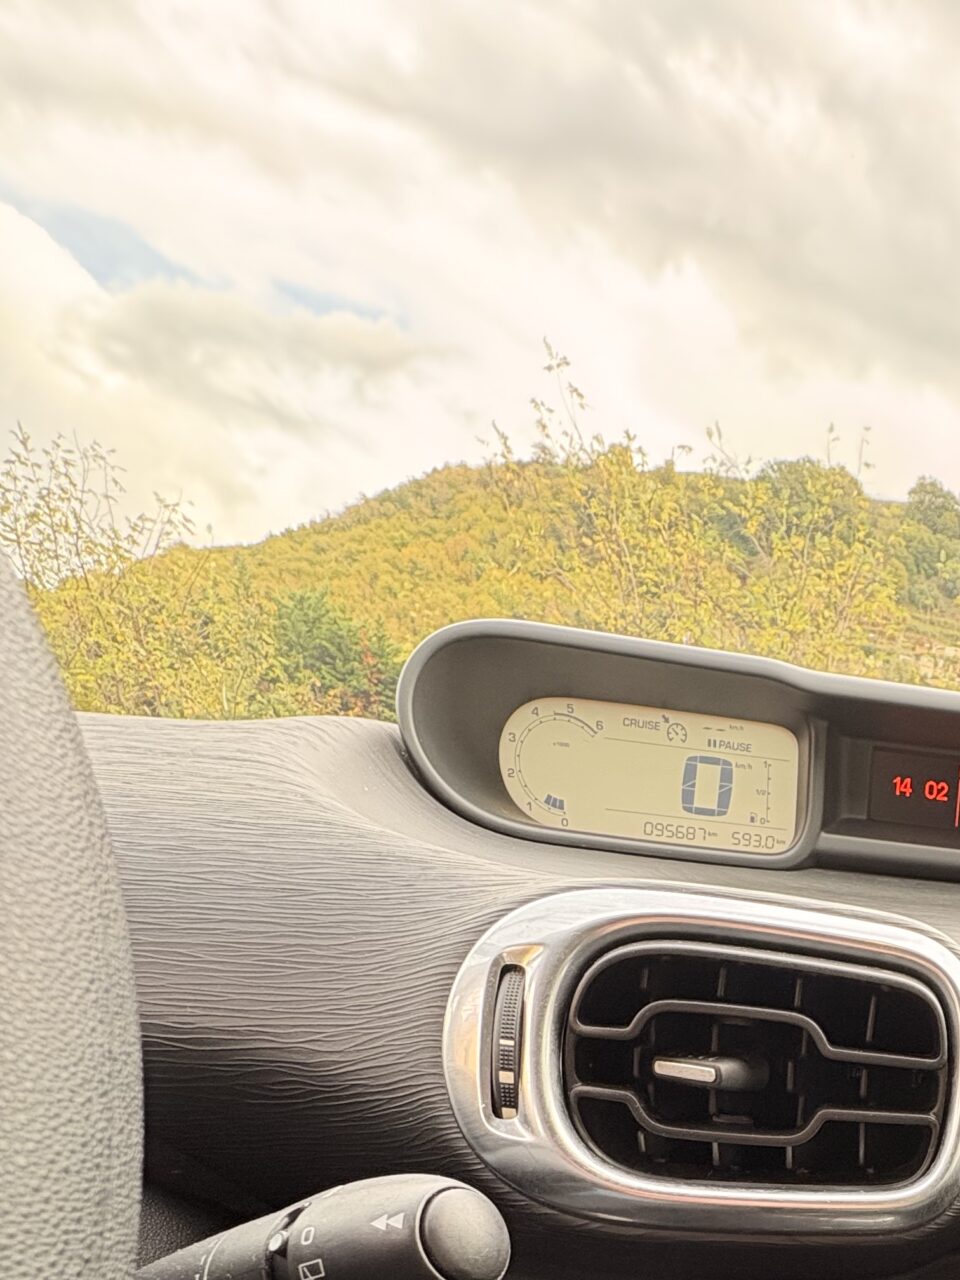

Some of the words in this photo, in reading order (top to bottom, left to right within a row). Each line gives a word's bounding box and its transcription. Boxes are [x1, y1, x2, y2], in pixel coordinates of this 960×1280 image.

[531, 707, 539, 717] 4
[566, 704, 574, 714] 5
[595, 720, 604, 731] 6
[622, 717, 661, 731] CRUISE
[508, 732, 516, 743] 3
[718, 740, 753, 753] PAUSE
[507, 768, 515, 778] 2
[681, 755, 733, 817] 0
[892, 776, 913, 797] 14
[924, 780, 949, 802] 02
[526, 801, 533, 812] 1
[561, 817, 569, 828] 0
[643, 821, 707, 841] 095687
[731, 831, 775, 850] 593.0
